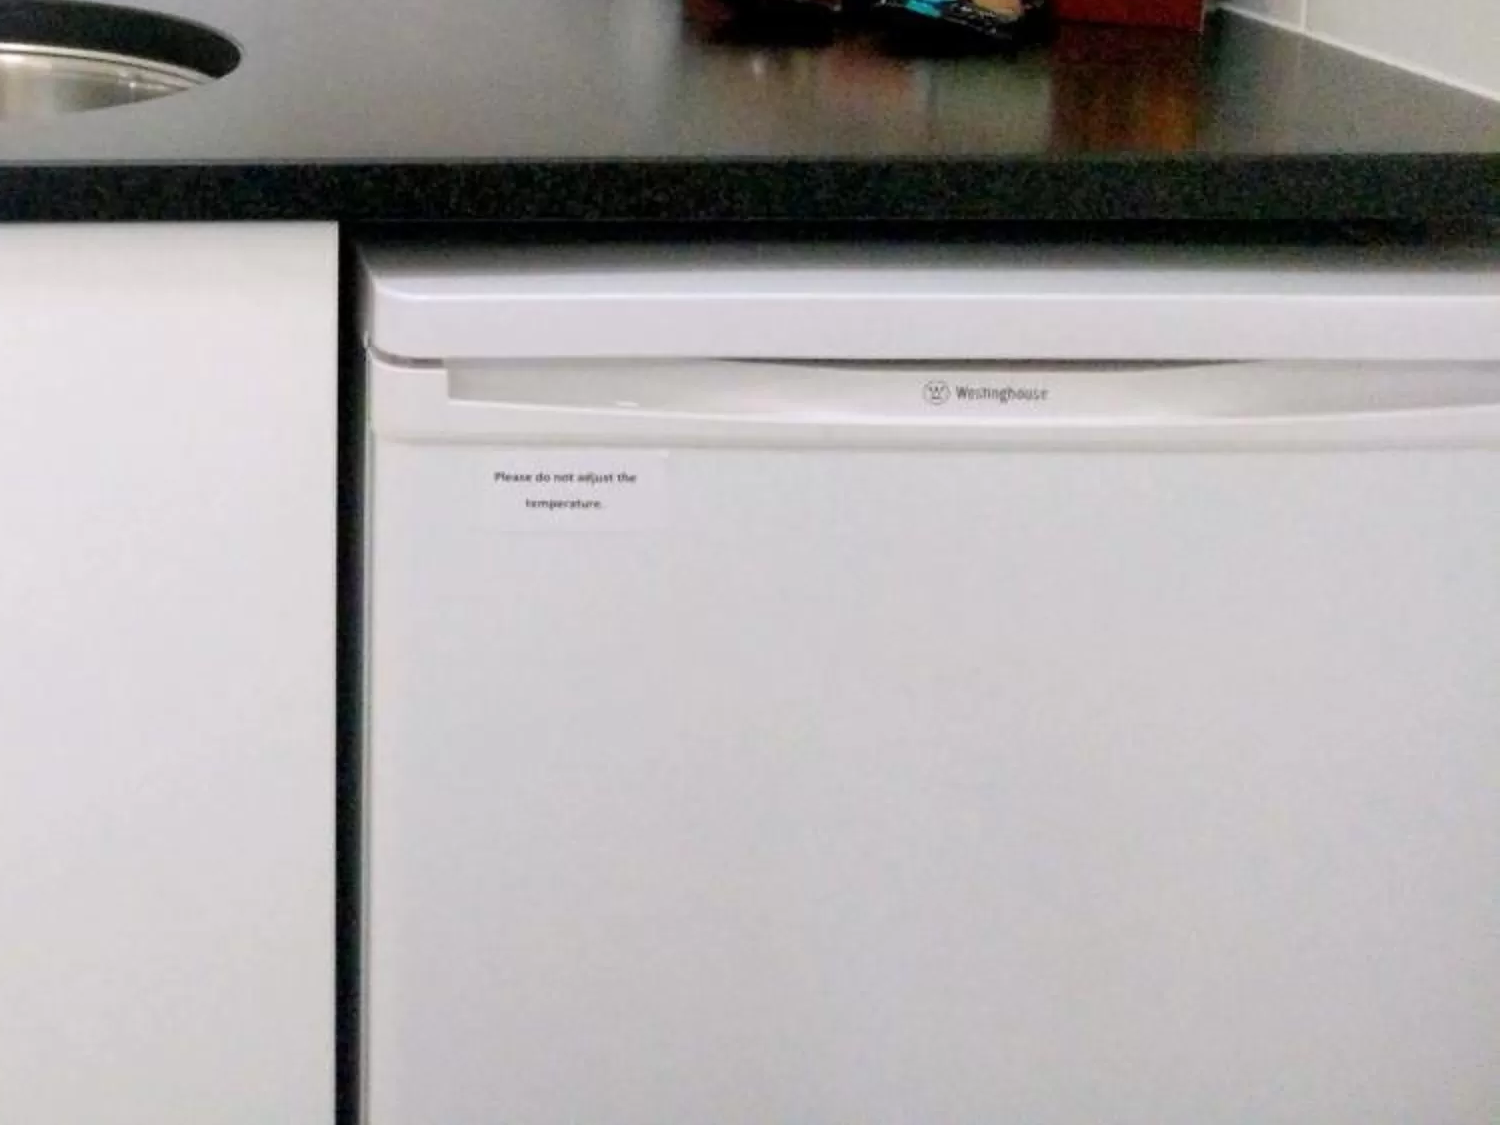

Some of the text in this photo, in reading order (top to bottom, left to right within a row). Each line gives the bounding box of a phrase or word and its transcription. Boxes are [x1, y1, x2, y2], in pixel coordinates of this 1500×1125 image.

[955, 385, 1049, 404] Westinghouse
[494, 471, 637, 487] Please do not adjust the
